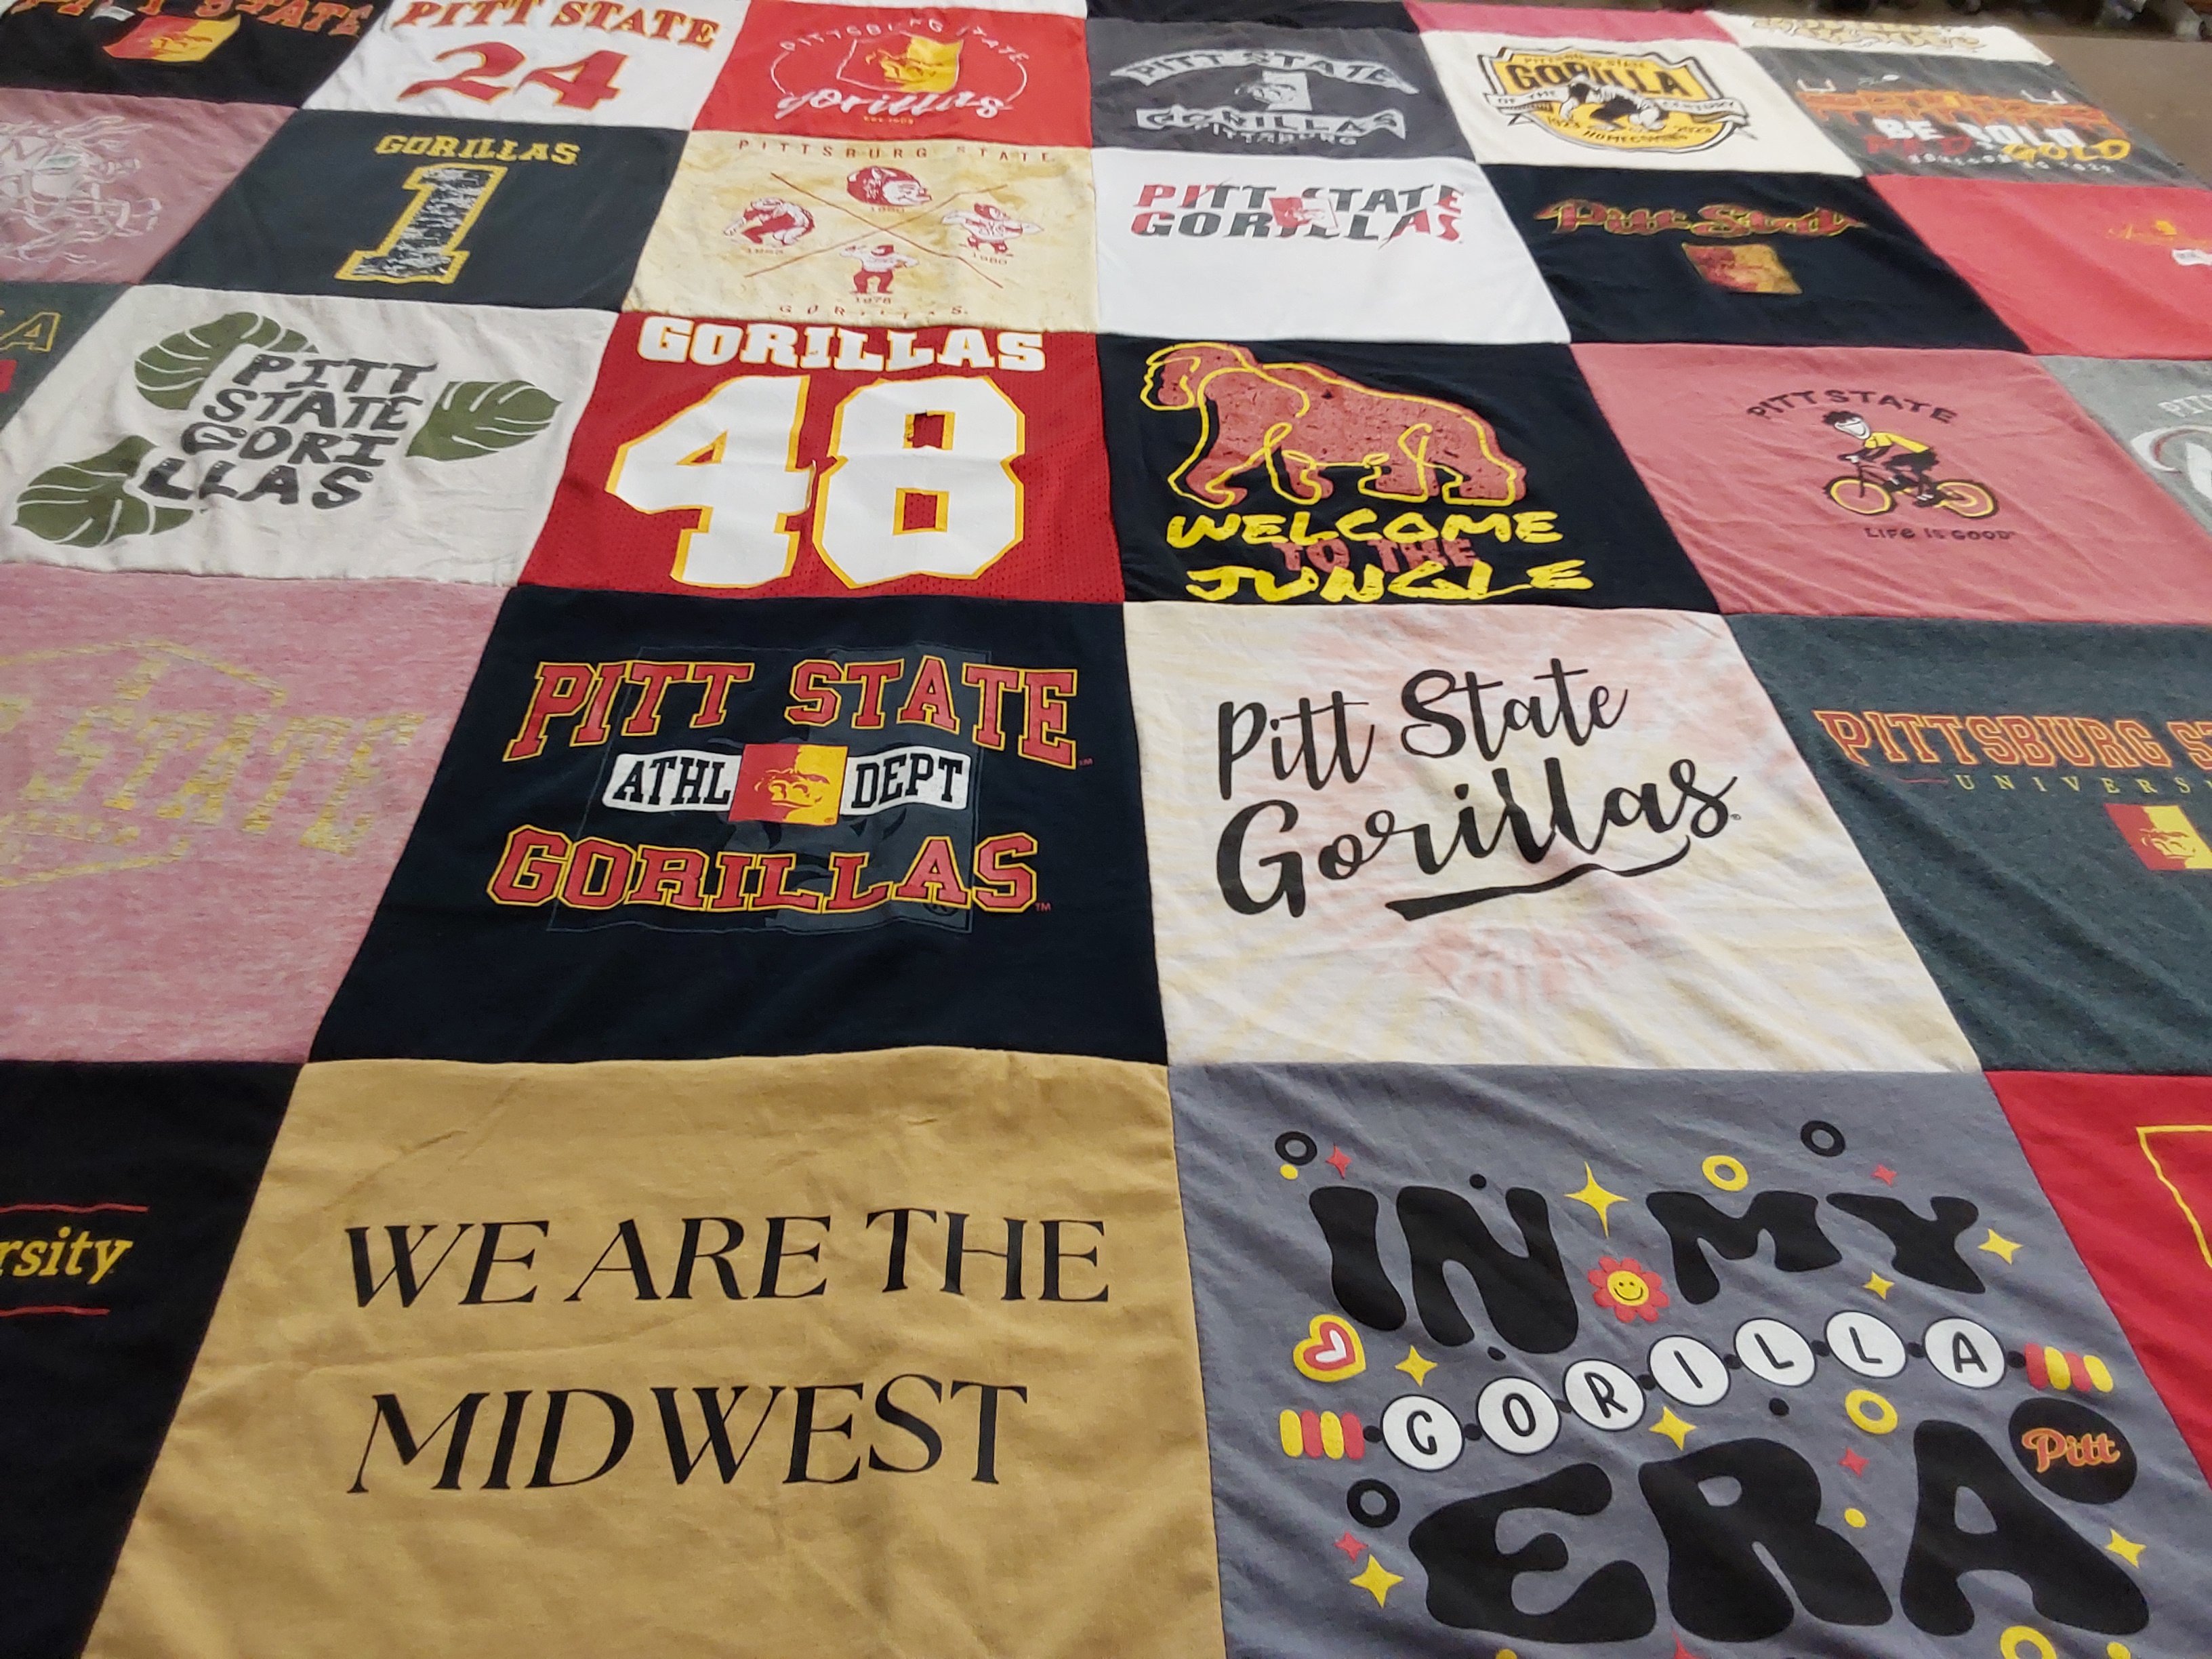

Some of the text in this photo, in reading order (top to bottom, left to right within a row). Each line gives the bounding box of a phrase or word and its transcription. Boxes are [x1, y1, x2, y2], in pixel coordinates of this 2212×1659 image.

[391, 1, 719, 51] PITT STATE
[396, 41, 629, 110] 24
[374, 135, 581, 165] GORILLAS
[739, 139, 1054, 163] PITTSBURG STATE
[1133, 179, 1276, 210] PITT
[335, 163, 508, 284] 1
[637, 316, 1046, 371] GORILLAS
[231, 353, 438, 394] PITT
[203, 387, 423, 430] STATE
[1746, 389, 1958, 424] PITT STATE
[181, 422, 400, 468] GORI
[138, 457, 375, 510] LLAS
[605, 375, 1025, 589] 48
[1166, 508, 1563, 548] WELCOME
[1272, 537, 1479, 574] TO THE
[1950, 529, 2015, 541] GOOD
[1187, 560, 1595, 602] JUNGLE
[502, 659, 755, 762] PITT
[783, 655, 1079, 770] STATE
[1217, 658, 1628, 800] Pitt State
[1811, 710, 2173, 769] PITTSBURG
[612, 754, 964, 810] ATHL DEPT
[1954, 773, 2212, 794] UNIVERS
[1216, 757, 1738, 919] Gorillas
[487, 824, 1038, 915] GORILLAS
[0, 1226, 134, 1284] rsity
[344, 1208, 1109, 1309] WE ARE THE
[1307, 1185, 1987, 1355] IN MY
[1403, 1327, 1989, 1457] GORILLA
[346, 1374, 1028, 1494] MIDWEST
[2022, 1427, 2121, 1473] Pitt
[1408, 1419, 2150, 1645] ERA
